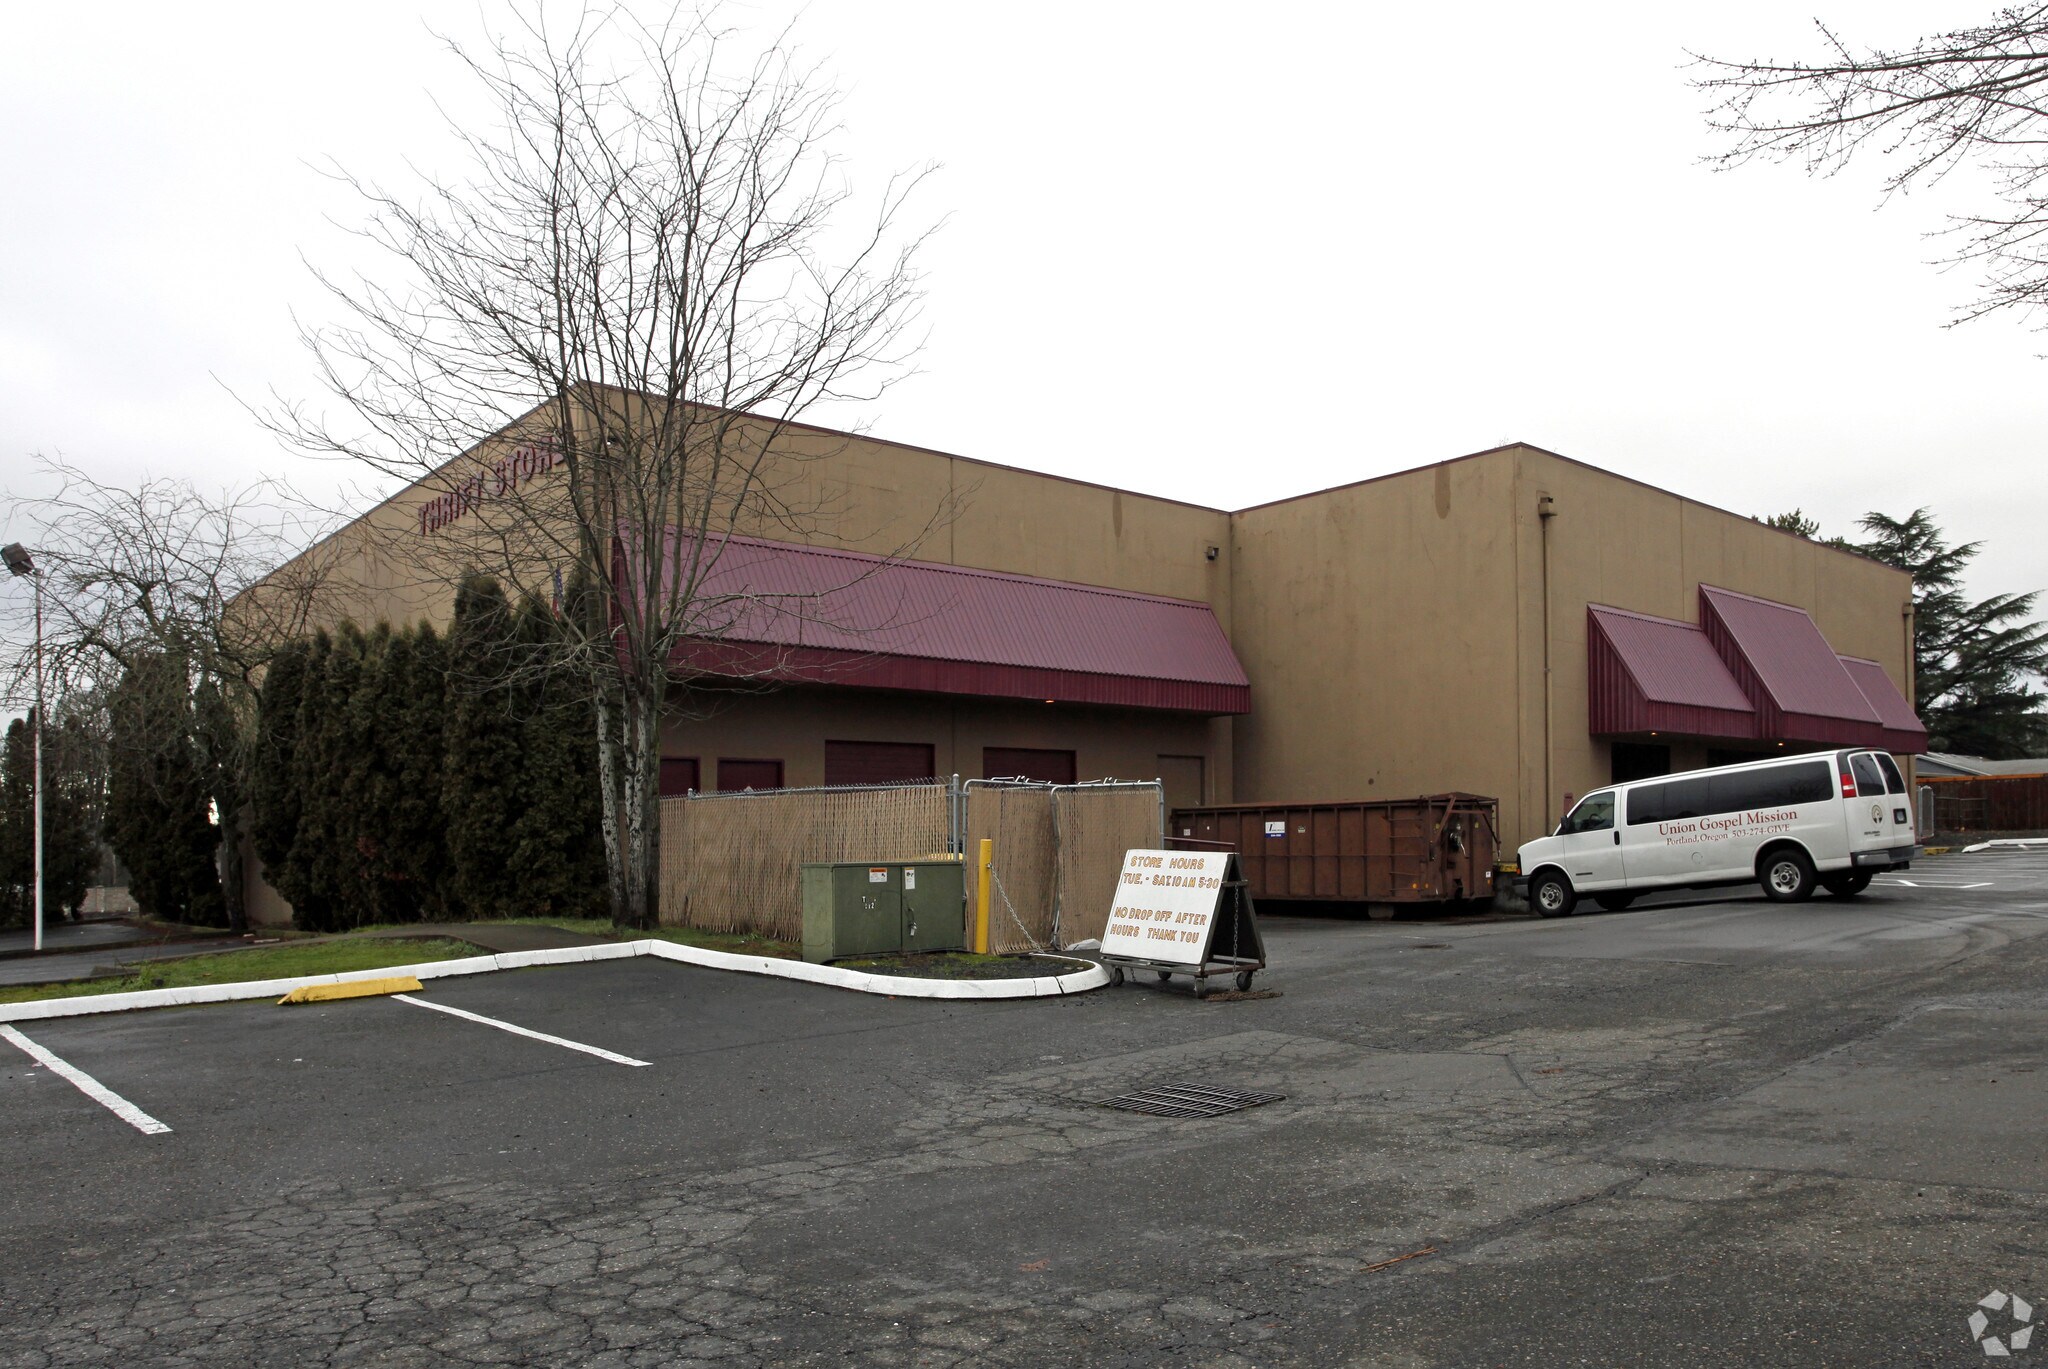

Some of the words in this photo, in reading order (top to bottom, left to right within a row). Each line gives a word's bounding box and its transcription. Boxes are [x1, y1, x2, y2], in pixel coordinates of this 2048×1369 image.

[1658, 823, 1696, 836] Union
[1700, 813, 1742, 832] Gospel
[1747, 809, 1798, 826] Mission
[1700, 833, 1728, 841] Oregon
[1732, 824, 1790, 837] 503-274-GIVE
[1130, 856, 1163, 869] STORE
[1169, 857, 1205, 870] HOURS
[1123, 873, 1143, 885] TUE.
[1198, 876, 1220, 889] 5:30
[1114, 906, 1128, 918] NO
[1128, 908, 1153, 920] DROP
[1154, 910, 1173, 922] OFF
[1175, 911, 1207, 926] AFTER
[1110, 923, 1140, 938] HOURS
[1147, 927, 1178, 942] THANK
[1180, 931, 1200, 944] YOU
